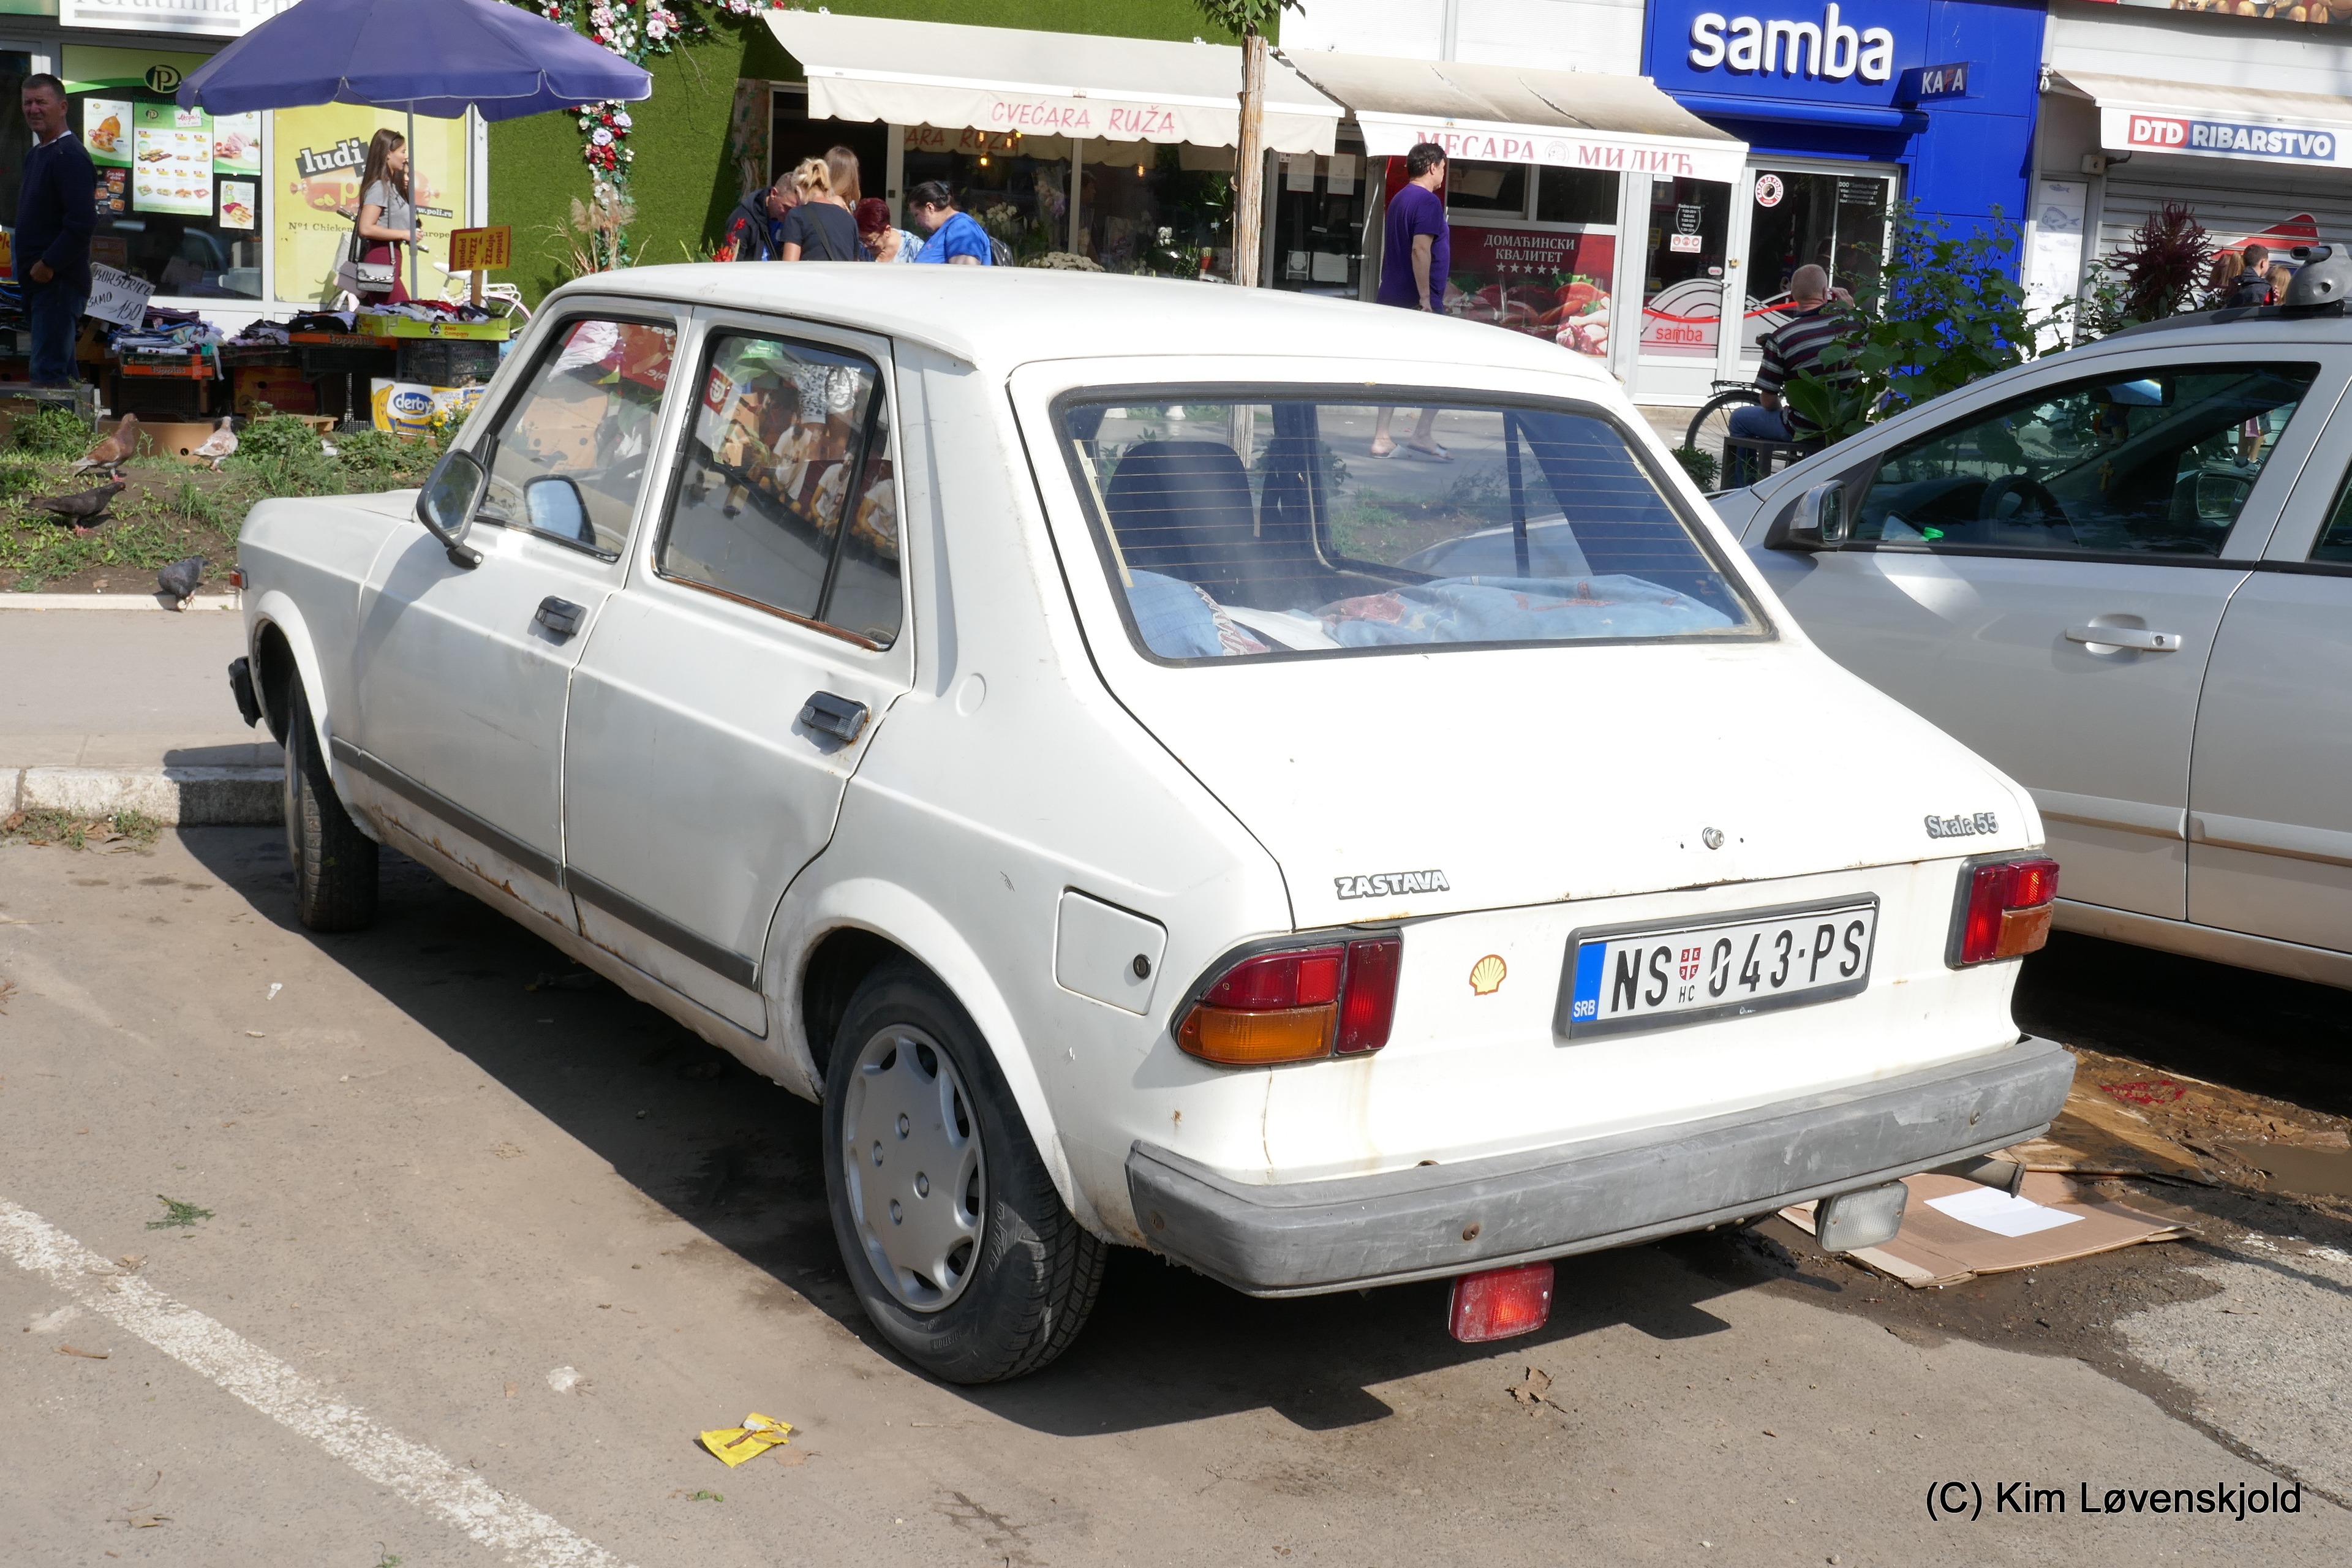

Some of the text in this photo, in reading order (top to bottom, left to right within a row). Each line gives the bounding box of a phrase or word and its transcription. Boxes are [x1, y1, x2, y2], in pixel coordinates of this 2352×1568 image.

[1689, 2, 1894, 81] samba
[1921, 68, 1964, 94] KAFA
[992, 100, 1175, 135] CVEĆARA RUŽA
[2133, 118, 2332, 157] DTD RIBARSTVO
[301, 139, 364, 173] ludi
[1417, 131, 1534, 160] МЕСАРА
[1578, 145, 1694, 176] МИЛИЋ
[417, 207, 452, 217] w.poli.rs
[312, 223, 353, 232] Chicken
[1483, 234, 1575, 250] ДОМАЋИНСКИ
[1495, 249, 1563, 262] КВАЛИТЕТ
[88, 292, 143, 321] SAMO 150
[1656, 325, 1703, 342] samba
[396, 393, 432, 414] derby
[1924, 812, 1999, 839] Skala 55
[1334, 869, 1450, 900] ZASTAVA
[1611, 944, 1672, 1012] NS
[1573, 1000, 1596, 1018] SRB
